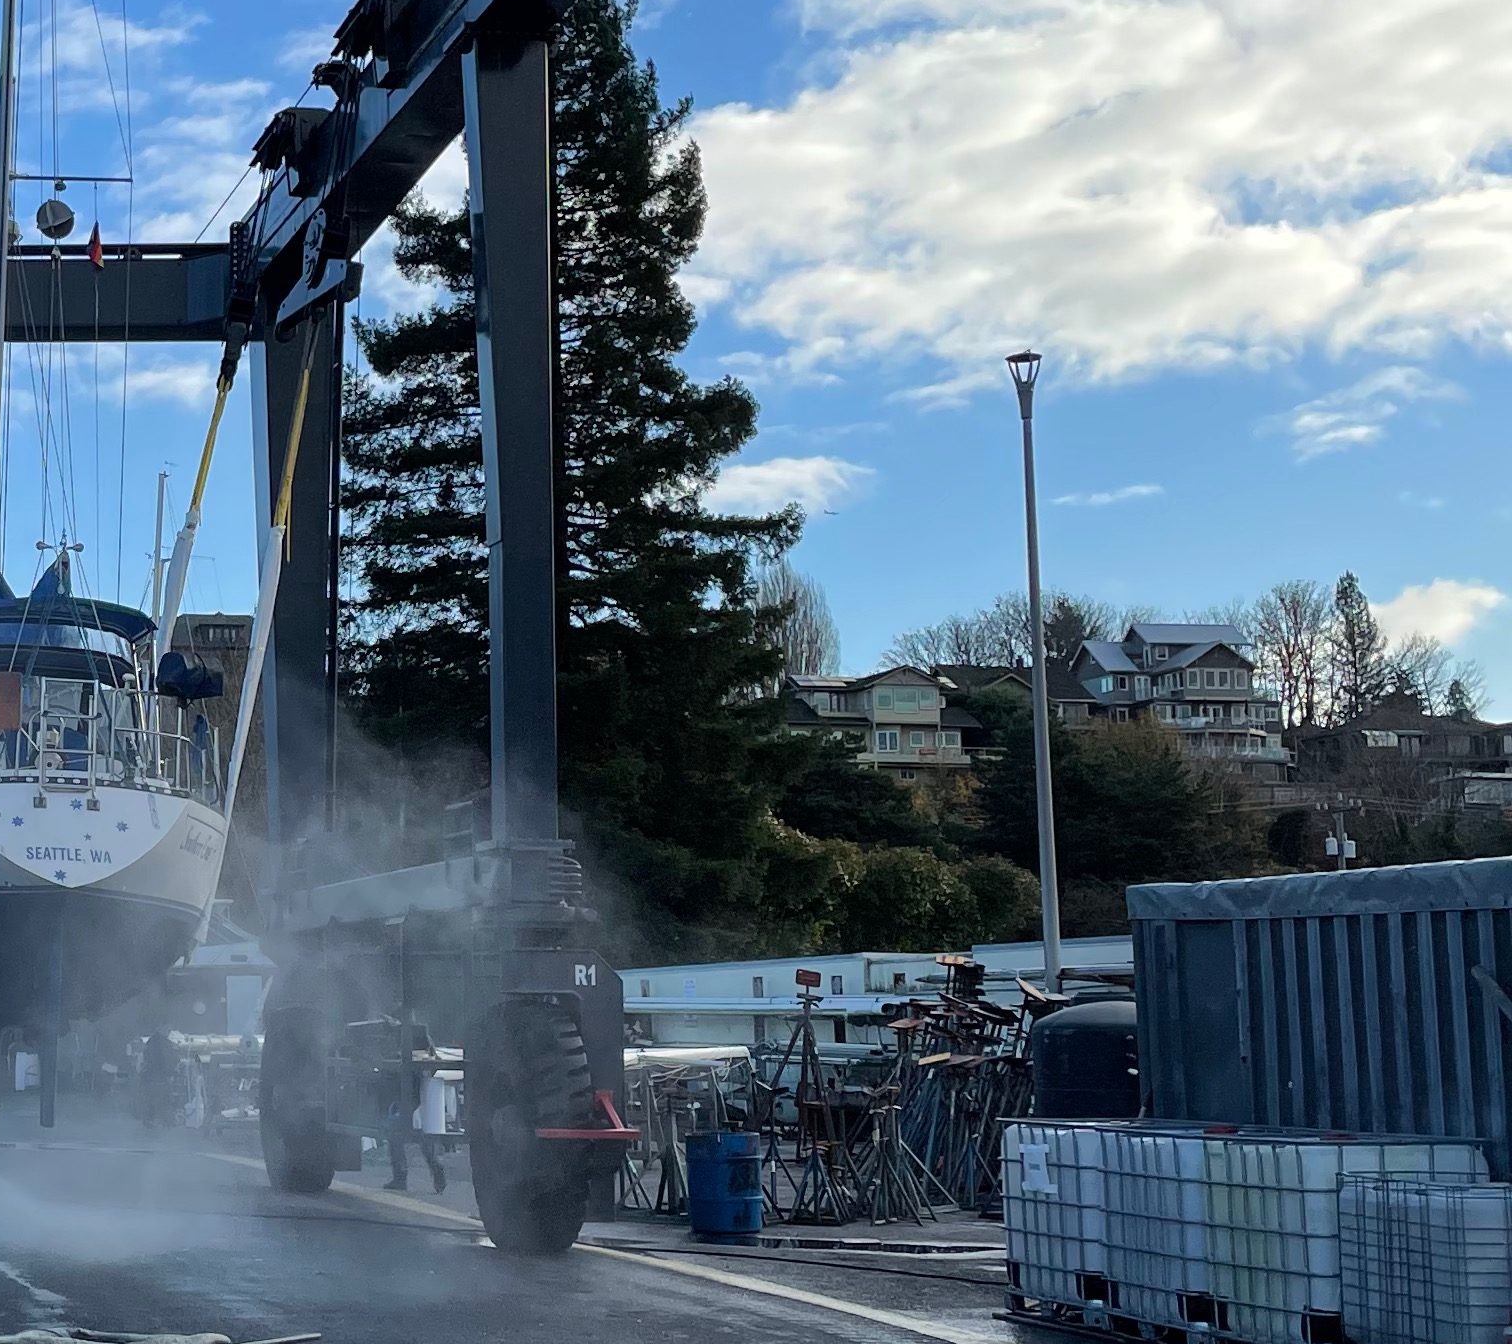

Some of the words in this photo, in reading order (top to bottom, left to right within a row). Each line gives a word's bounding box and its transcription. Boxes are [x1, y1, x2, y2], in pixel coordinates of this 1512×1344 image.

[26, 846, 87, 864] SEATTLE,
[90, 849, 112, 864] WA
[574, 964, 597, 986] R1
